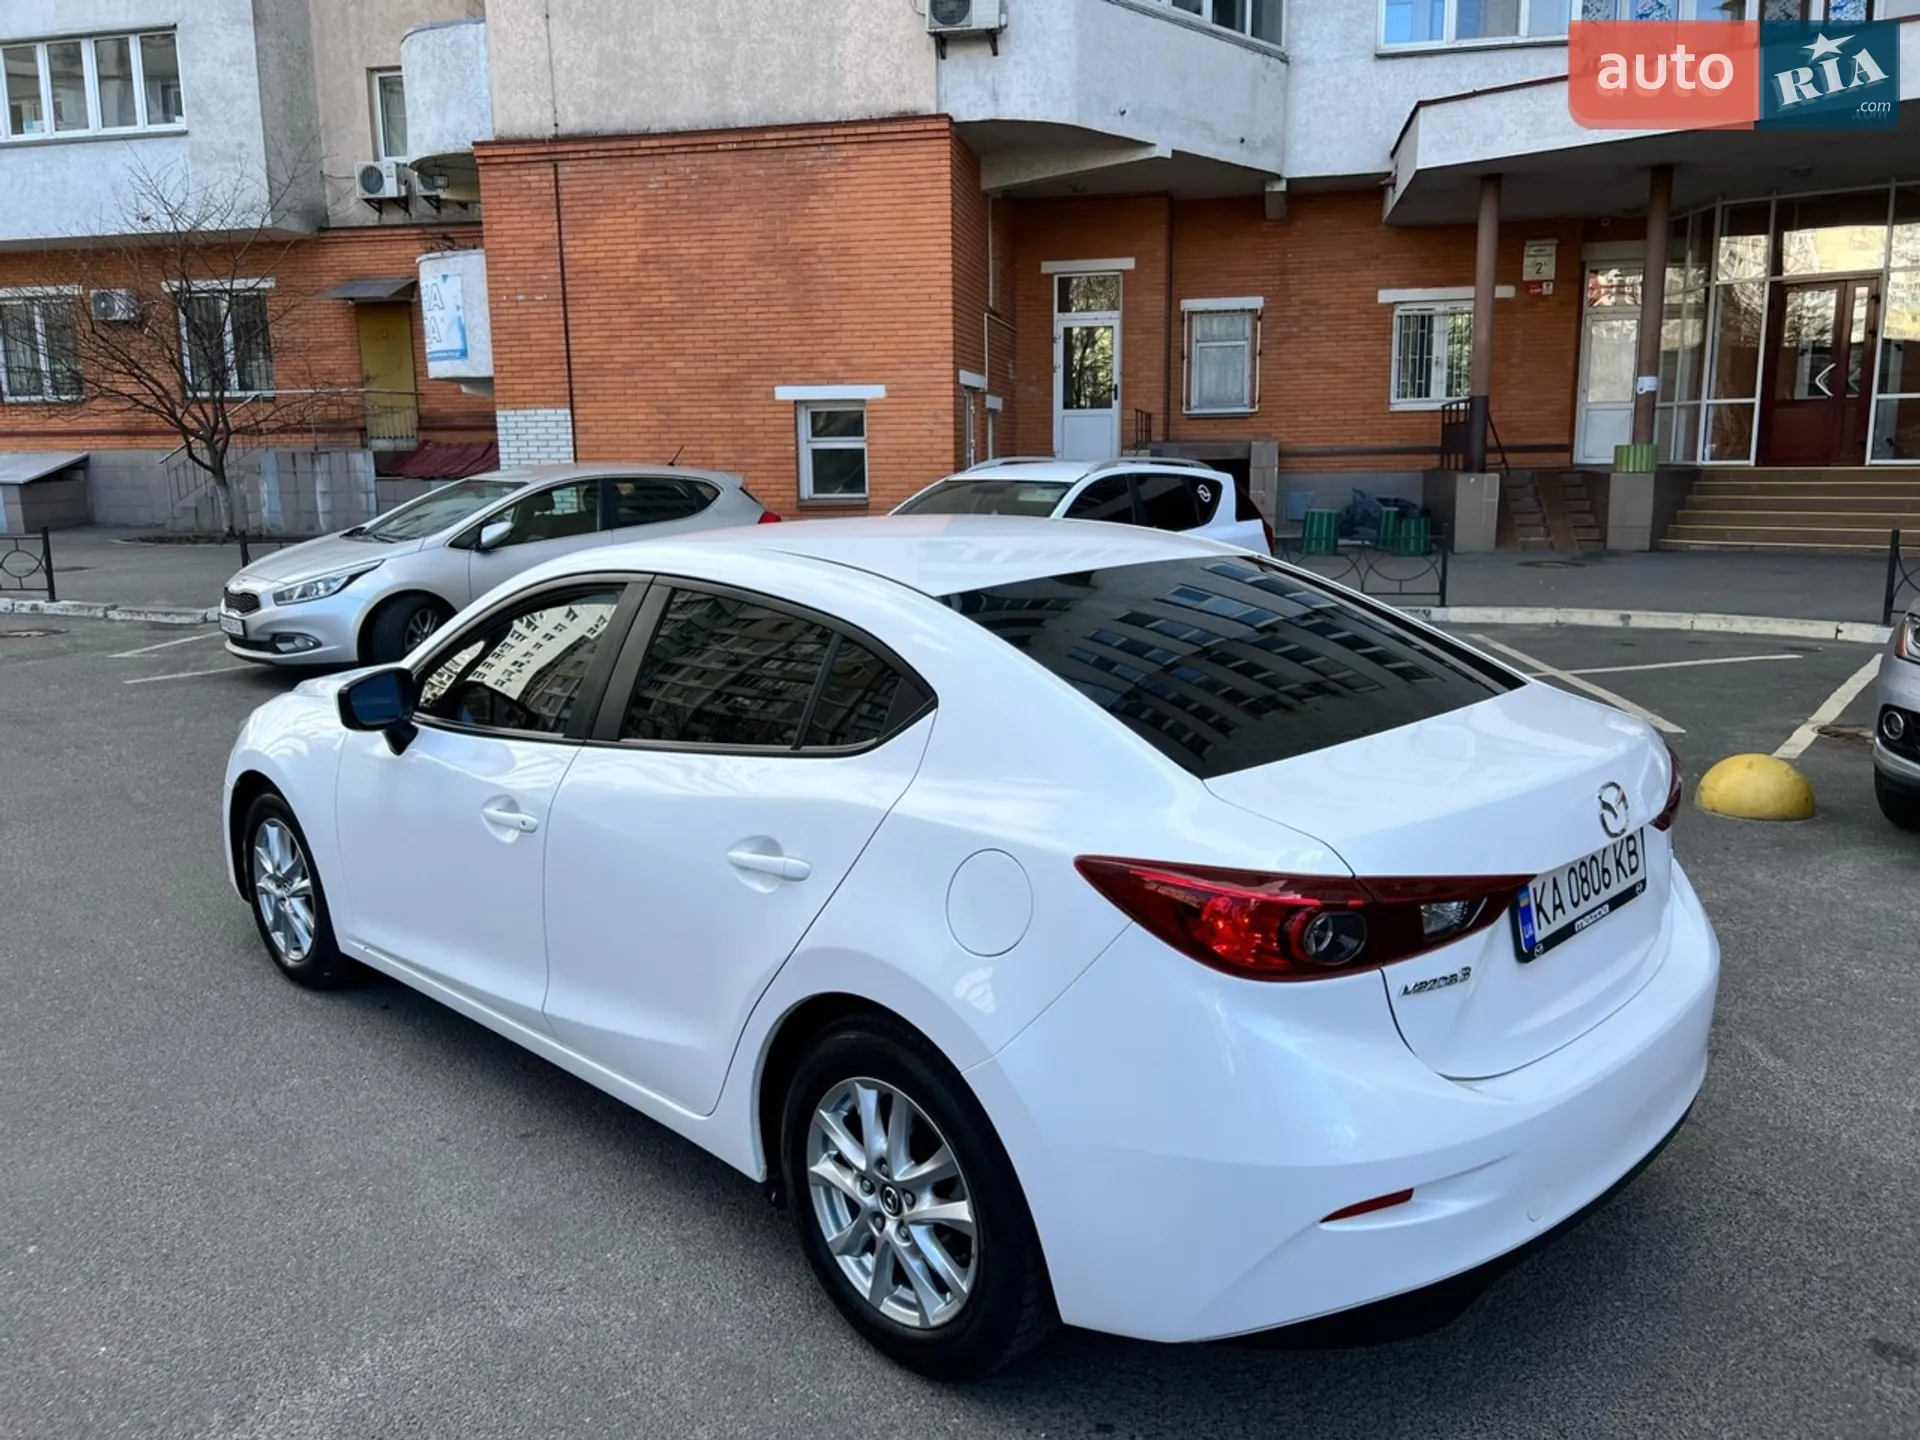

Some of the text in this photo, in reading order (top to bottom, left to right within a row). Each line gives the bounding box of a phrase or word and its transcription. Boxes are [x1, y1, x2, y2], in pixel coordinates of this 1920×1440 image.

[1533, 833, 1640, 930] KA 0806 KB
